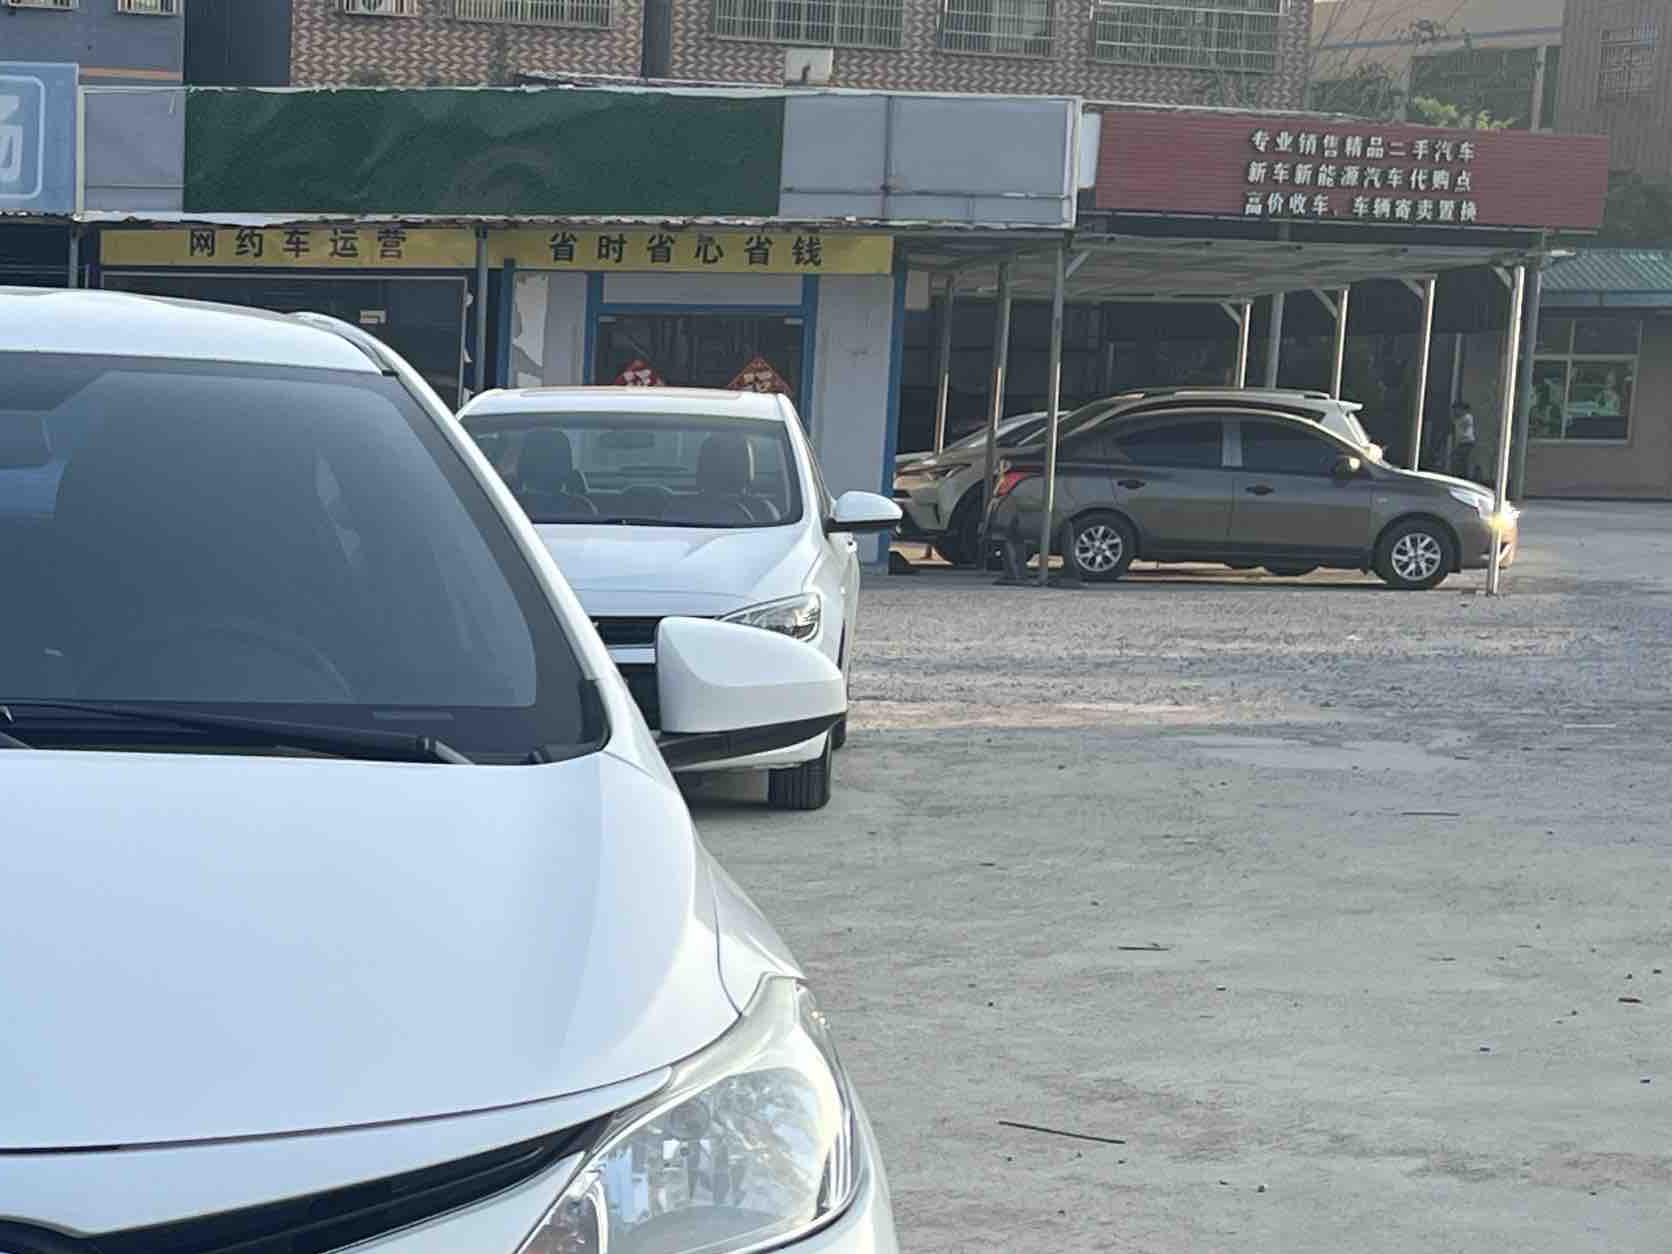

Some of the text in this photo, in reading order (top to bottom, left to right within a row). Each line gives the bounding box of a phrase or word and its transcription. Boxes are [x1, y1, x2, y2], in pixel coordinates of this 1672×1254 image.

[1251, 129, 1476, 163] 专业销售精品二手汽车
[1247, 160, 1472, 192] 新车新能源汽车代购点
[189, 227, 409, 261] 网约车运营
[548, 232, 824, 266] 省时省心省钱
